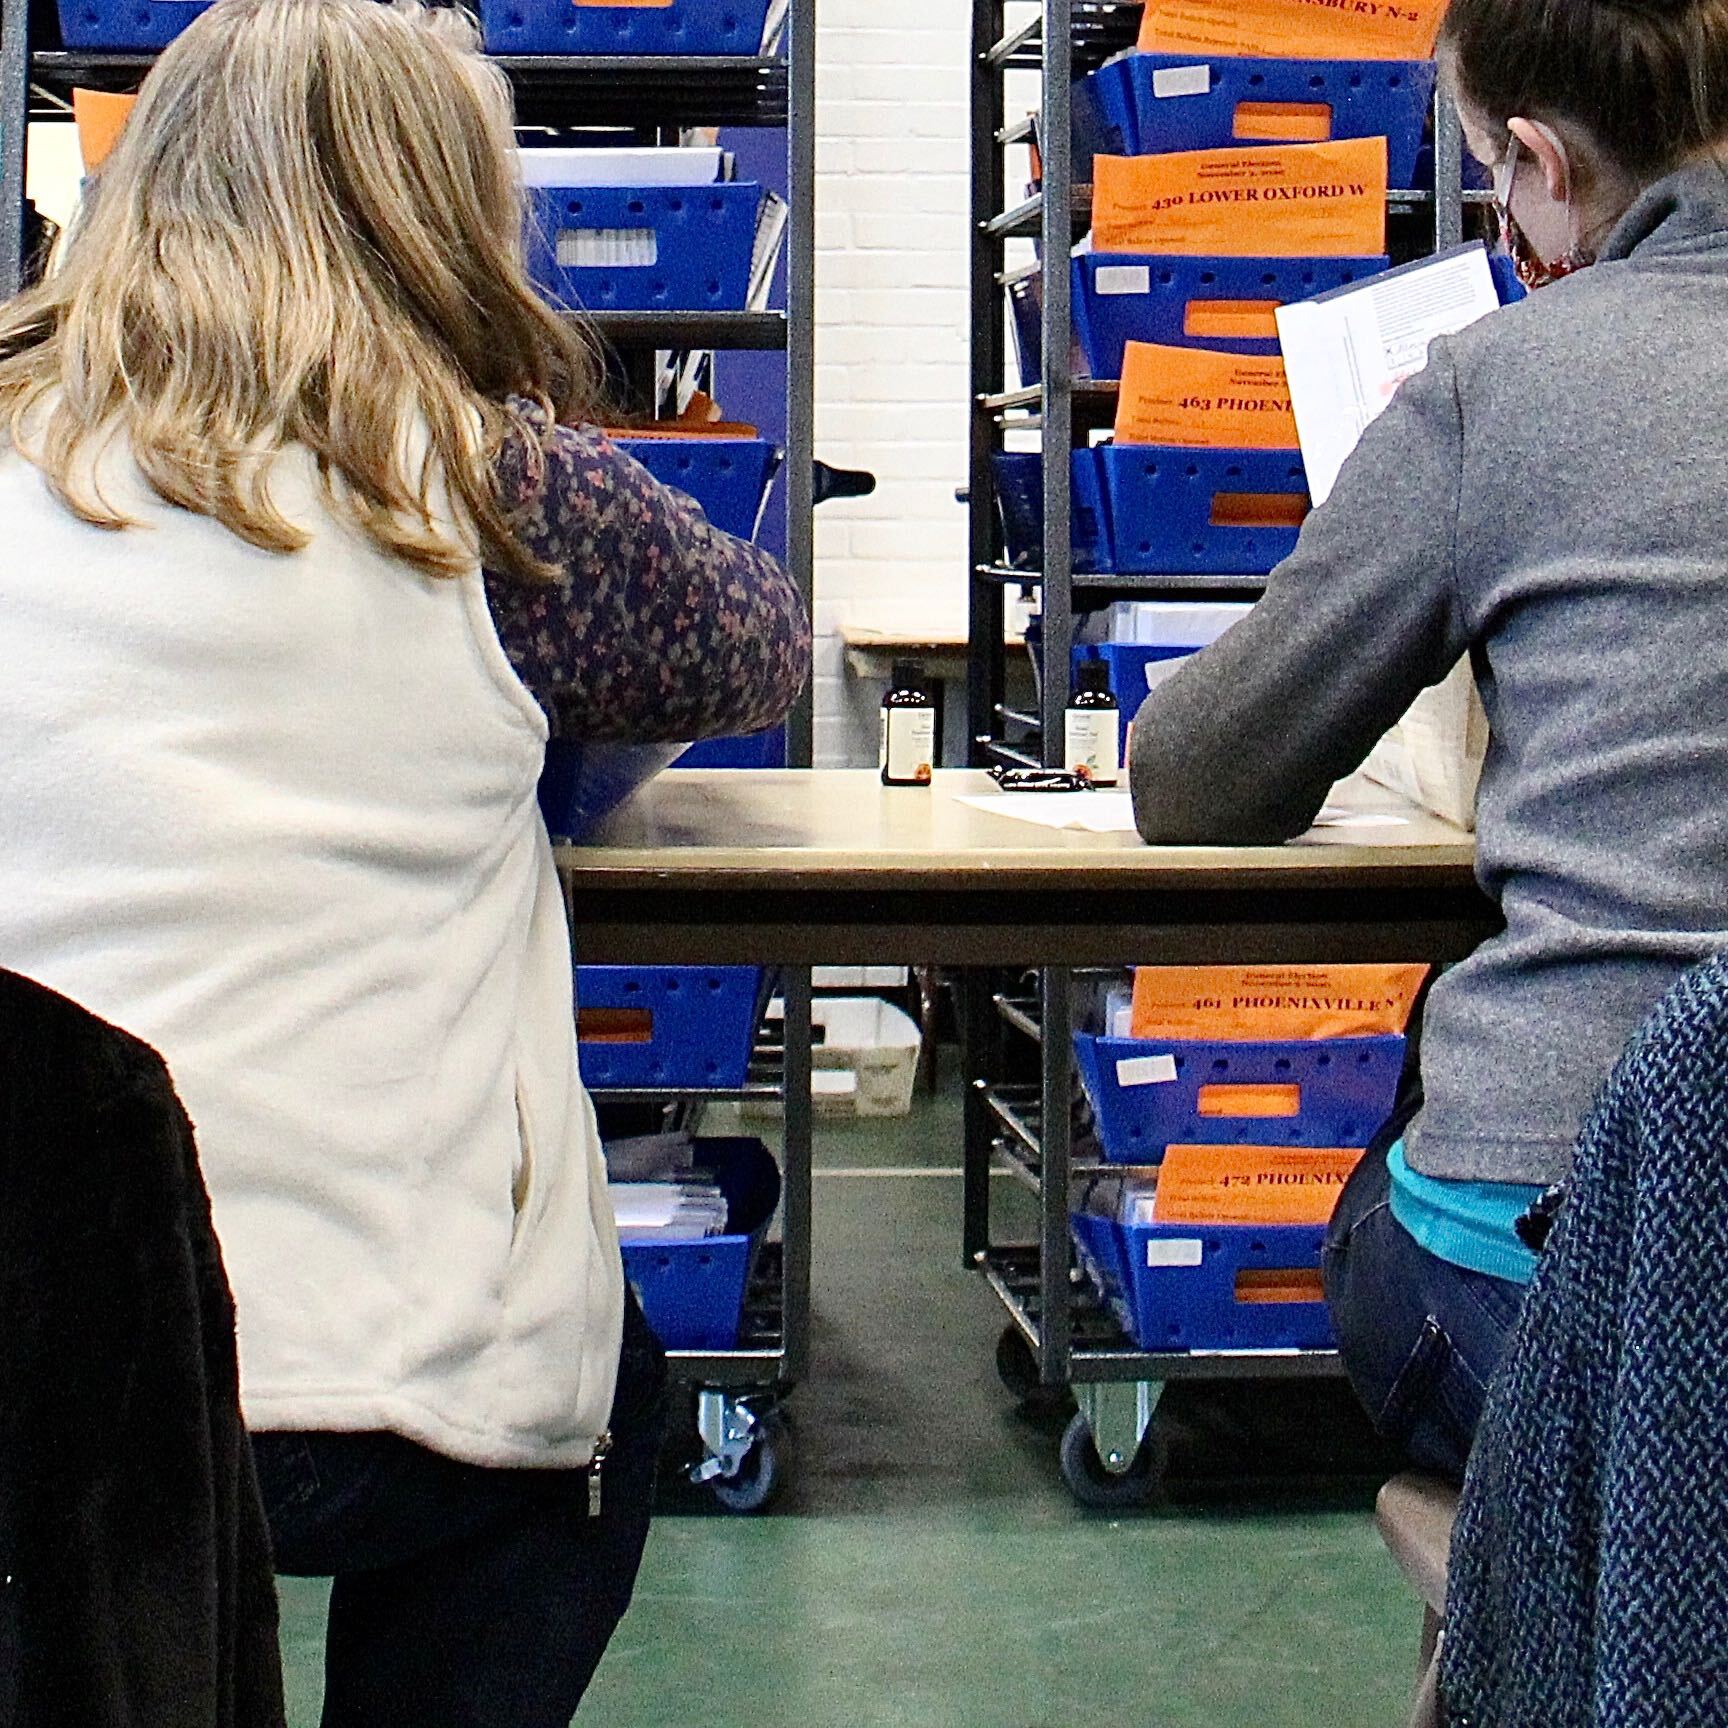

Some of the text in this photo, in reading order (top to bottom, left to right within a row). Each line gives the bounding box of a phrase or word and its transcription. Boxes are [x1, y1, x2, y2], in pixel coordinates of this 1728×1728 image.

[1386, 6, 1419, 21] N-2
[1152, 196, 1183, 210] 430
[1190, 188, 1258, 204] LOWER
[1263, 184, 1344, 200] OXFORD
[1349, 184, 1368, 196] W
[1179, 396, 1211, 410] 463
[1193, 999, 1221, 1010] 461
[1233, 997, 1380, 1010] PHOENIXVILLE
[1220, 1176, 1250, 1187] 472
